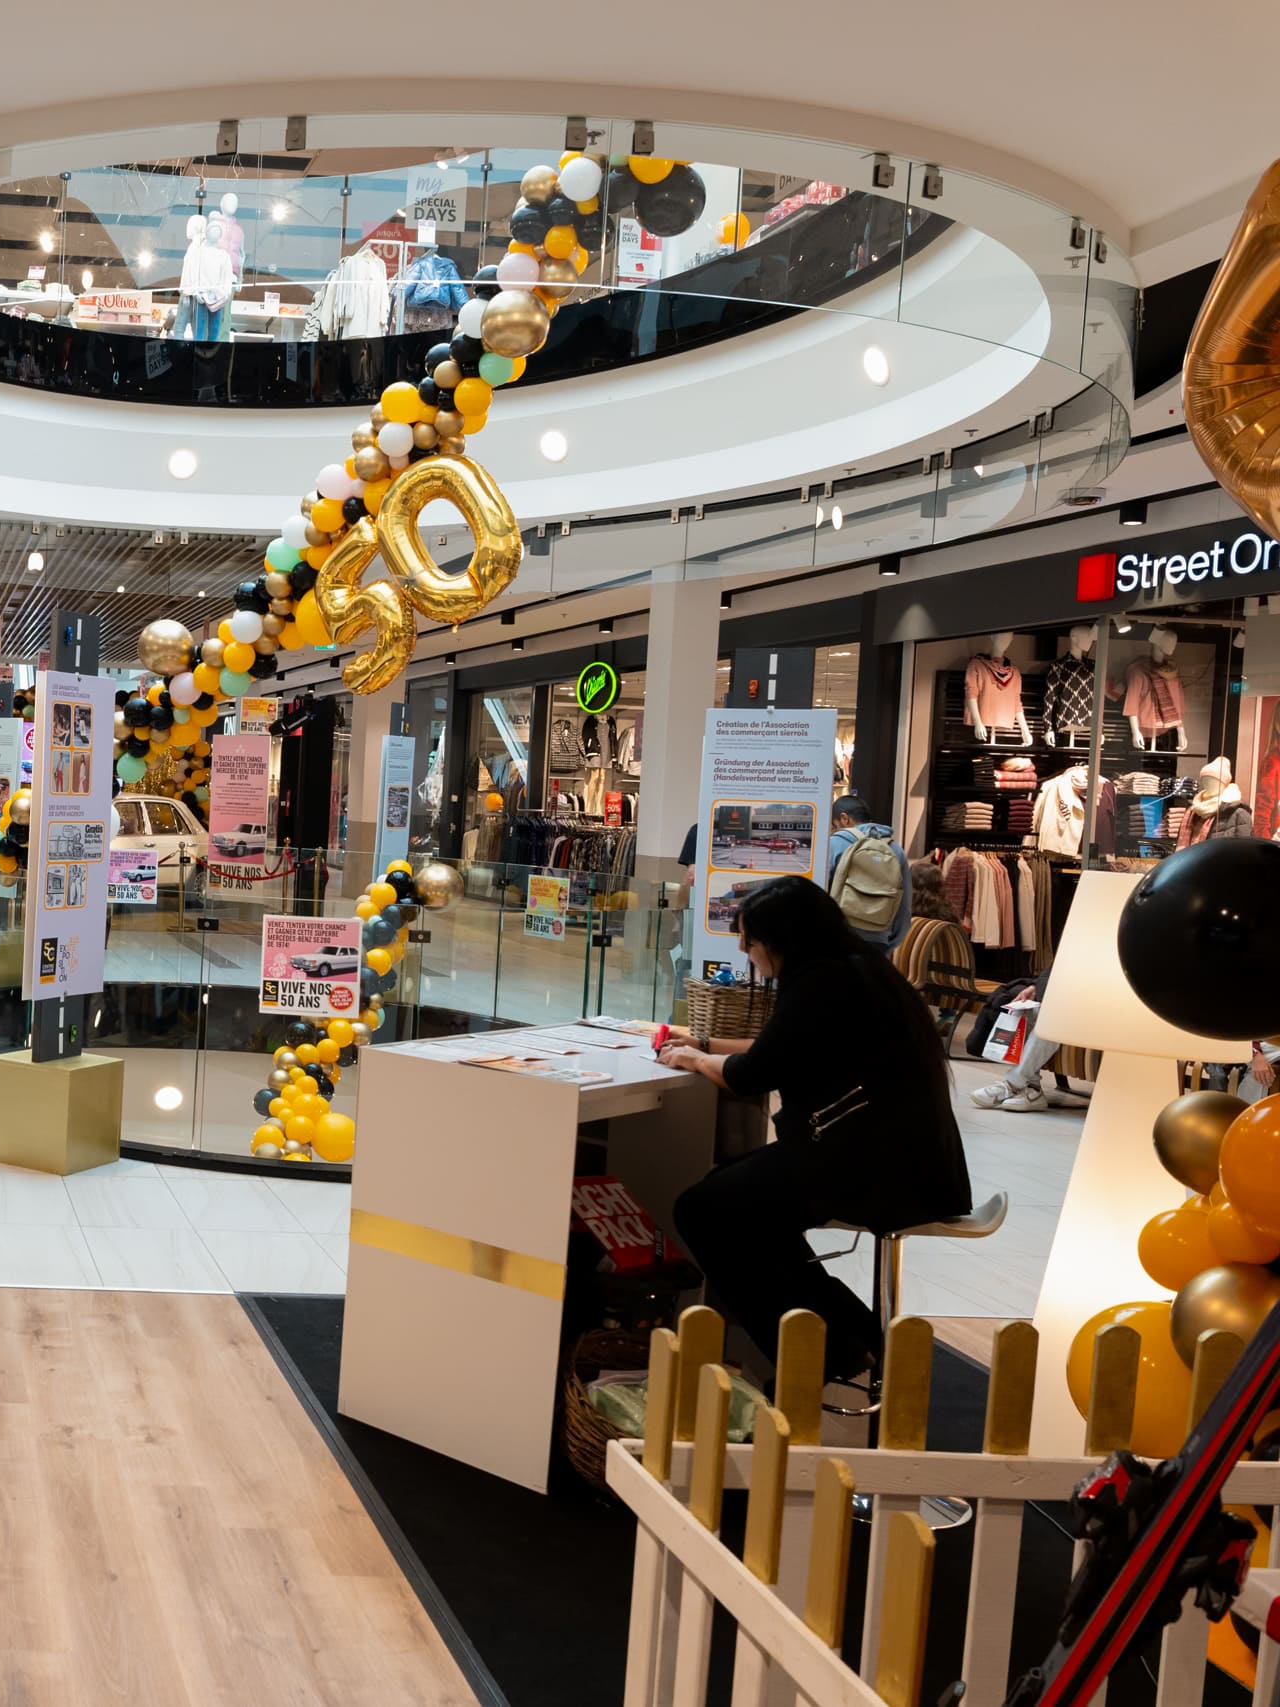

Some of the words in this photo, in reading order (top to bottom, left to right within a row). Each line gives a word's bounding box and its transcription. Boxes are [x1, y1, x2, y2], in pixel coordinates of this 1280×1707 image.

[414, 198, 457, 208] SPECIAL
[413, 207, 457, 222] DAYS
[1117, 540, 1225, 592] Street
[716, 720, 749, 729] Création
[761, 721, 810, 729] l'Association
[716, 728, 730, 736] des
[730, 729, 779, 737] commerçant
[780, 729, 808, 737] sierrois
[714, 759, 751, 768] Gründung
[766, 760, 810, 768] Association
[714, 766, 727, 774] des
[728, 768, 775, 776] commerçant
[776, 768, 804, 776] sierrois
[713, 774, 776, 783] (Handelsverband
[777, 775, 791, 783] von
[792, 775, 819, 785] Siders)
[223, 864, 241, 877] VIVE
[244, 866, 261, 878] NOS
[117, 884, 130, 892] VIVE
[223, 877, 234, 888] 50
[235, 878, 253, 890] ANS
[125, 892, 138, 900] ANS
[534, 915, 544, 923] VIVE
[267, 920, 285, 928] VENEZ
[286, 921, 305, 929] TENTER
[307, 922, 324, 930] VOTRE
[325, 923, 347, 931] CHANCE
[540, 924, 550, 934] ANS
[267, 934, 312, 942] MERCEDES-BENZ
[280, 981, 306, 994] VIVE
[309, 983, 332, 996] NOS
[280, 994, 295, 1007] 50
[298, 996, 321, 1008] ANS
[583, 1214, 655, 1251] PACK
